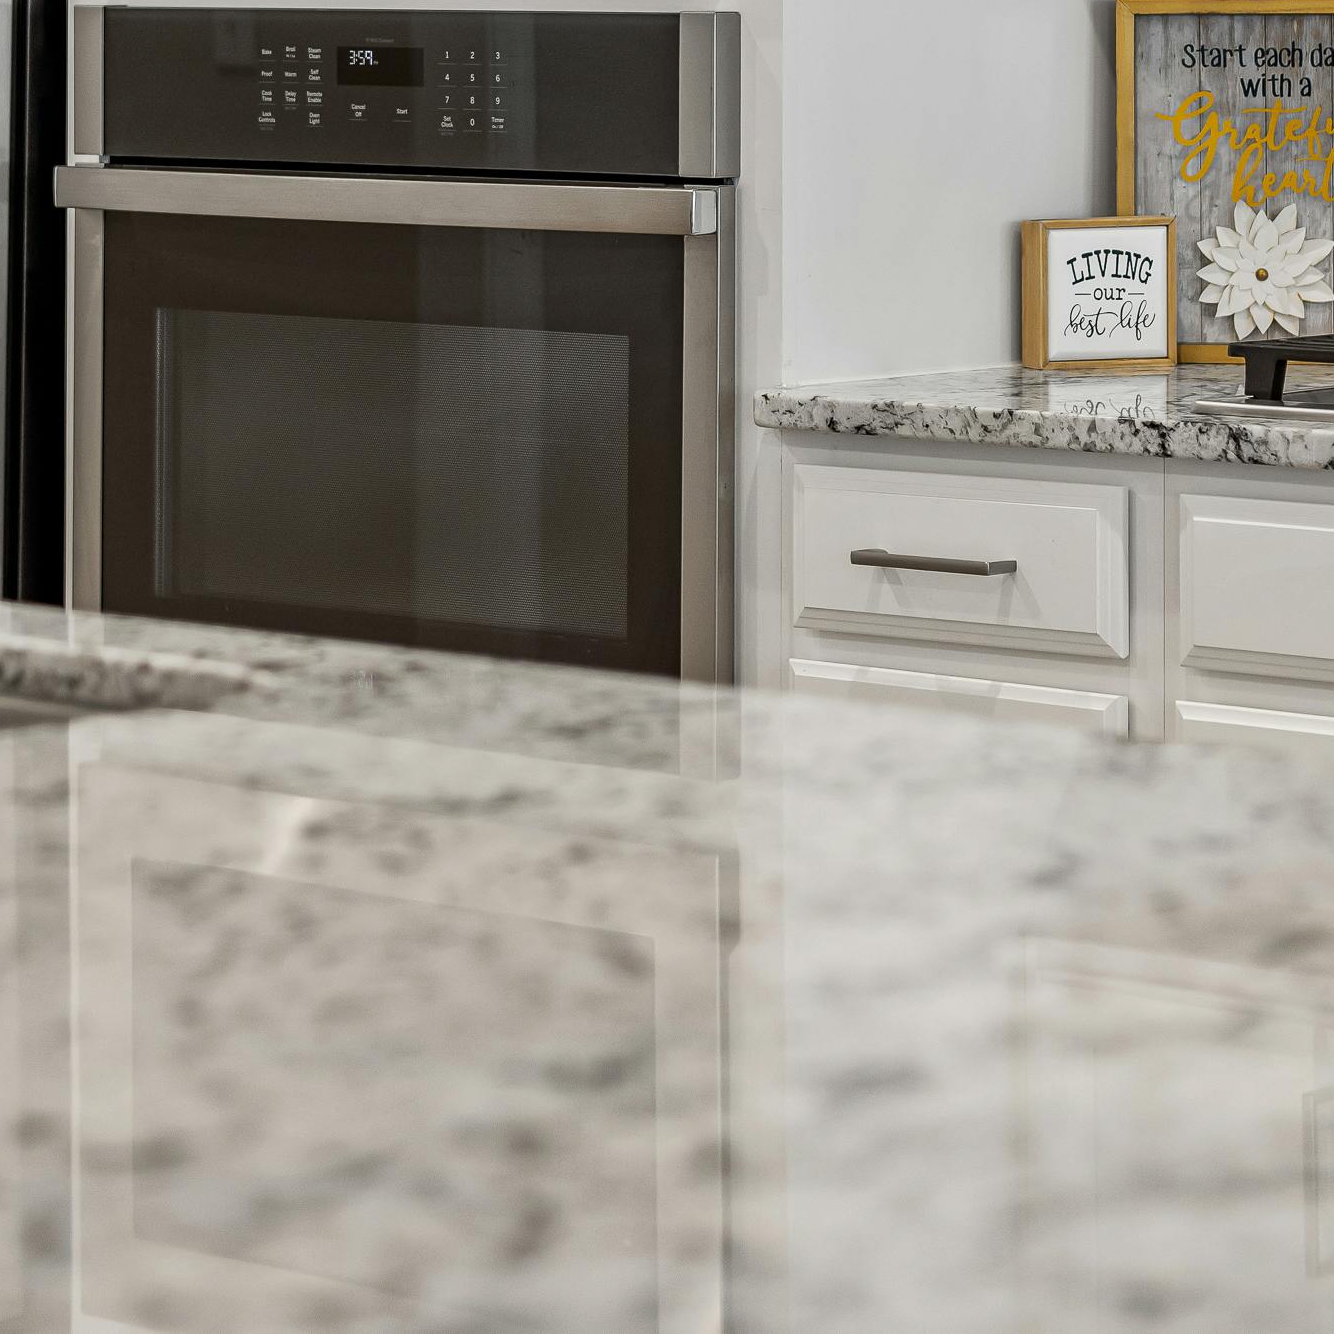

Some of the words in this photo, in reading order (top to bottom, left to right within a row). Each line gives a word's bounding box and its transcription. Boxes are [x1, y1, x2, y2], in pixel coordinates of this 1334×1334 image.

[349, 50, 373, 66] 3:59
[445, 50, 450, 59] 1
[470, 51, 475, 60] 2
[495, 51, 501, 60] 3
[1181, 44, 1246, 68] Start
[1253, 41, 1303, 67] each
[444, 73, 450, 81] 4
[470, 73, 475, 82] 5
[495, 74, 501, 83] 6
[1240, 74, 1292, 98] with
[1299, 77, 1312, 97] a
[445, 95, 450, 104] 7
[470, 96, 475, 105] 8
[495, 96, 501, 105] 9
[443, 115, 452, 123] Set
[470, 118, 475, 127] 0
[1066, 249, 1154, 285] LIVING
[1093, 288, 1126, 300] our
[1064, 303, 1119, 338] best
[1109, 300, 1156, 341] life
